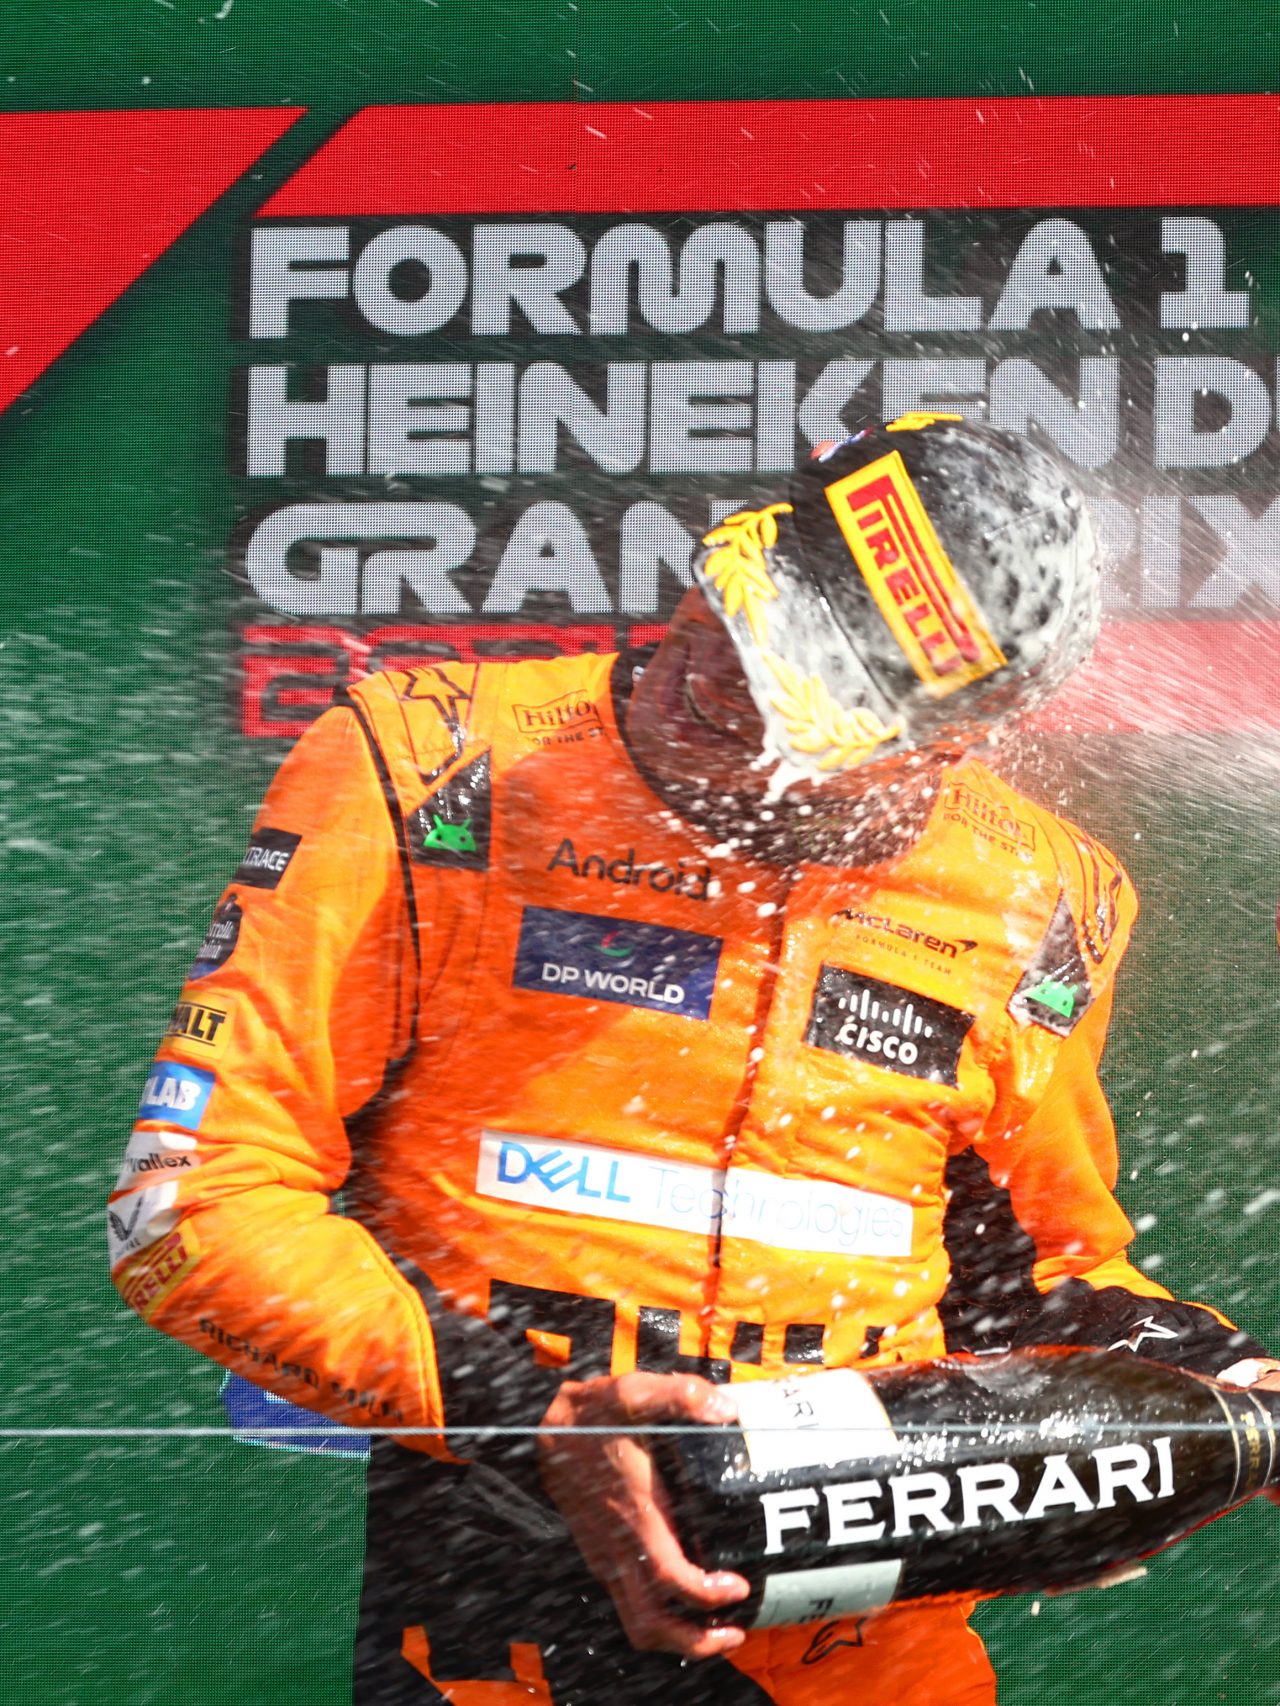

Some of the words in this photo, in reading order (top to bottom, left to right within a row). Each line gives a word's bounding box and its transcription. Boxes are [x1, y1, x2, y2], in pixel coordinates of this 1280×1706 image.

[250, 217, 1122, 339] FORMULA
[1160, 216, 1250, 328] 1
[247, 356, 1120, 476] HEINEKEN
[244, 499, 750, 614] GRAN
[846, 474, 982, 677] PIRELLI
[547, 837, 713, 901] Android
[542, 962, 579, 984] DP
[584, 969, 686, 1005] WORLD
[829, 908, 958, 959] McLaren
[497, 1141, 632, 1203] DELL
[650, 1165, 907, 1247] Technologies
[760, 1437, 1177, 1555] FERRARI
